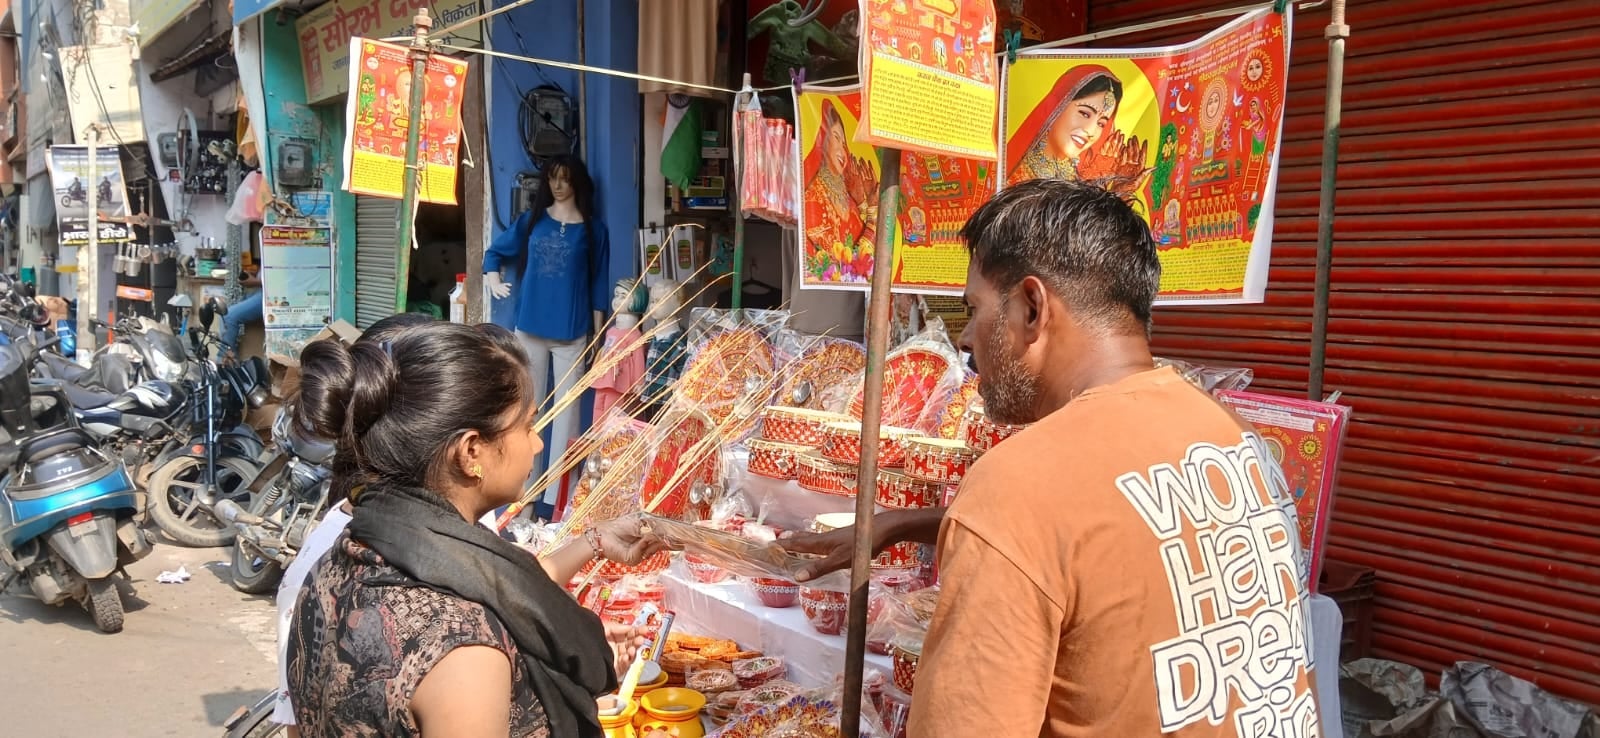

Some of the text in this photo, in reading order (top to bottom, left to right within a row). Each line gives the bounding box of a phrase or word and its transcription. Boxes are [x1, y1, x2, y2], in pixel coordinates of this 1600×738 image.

[441, 1, 477, 26] विक्रेता
[321, 3, 381, 53] सौरभ
[57, 466, 73, 475] TVS
